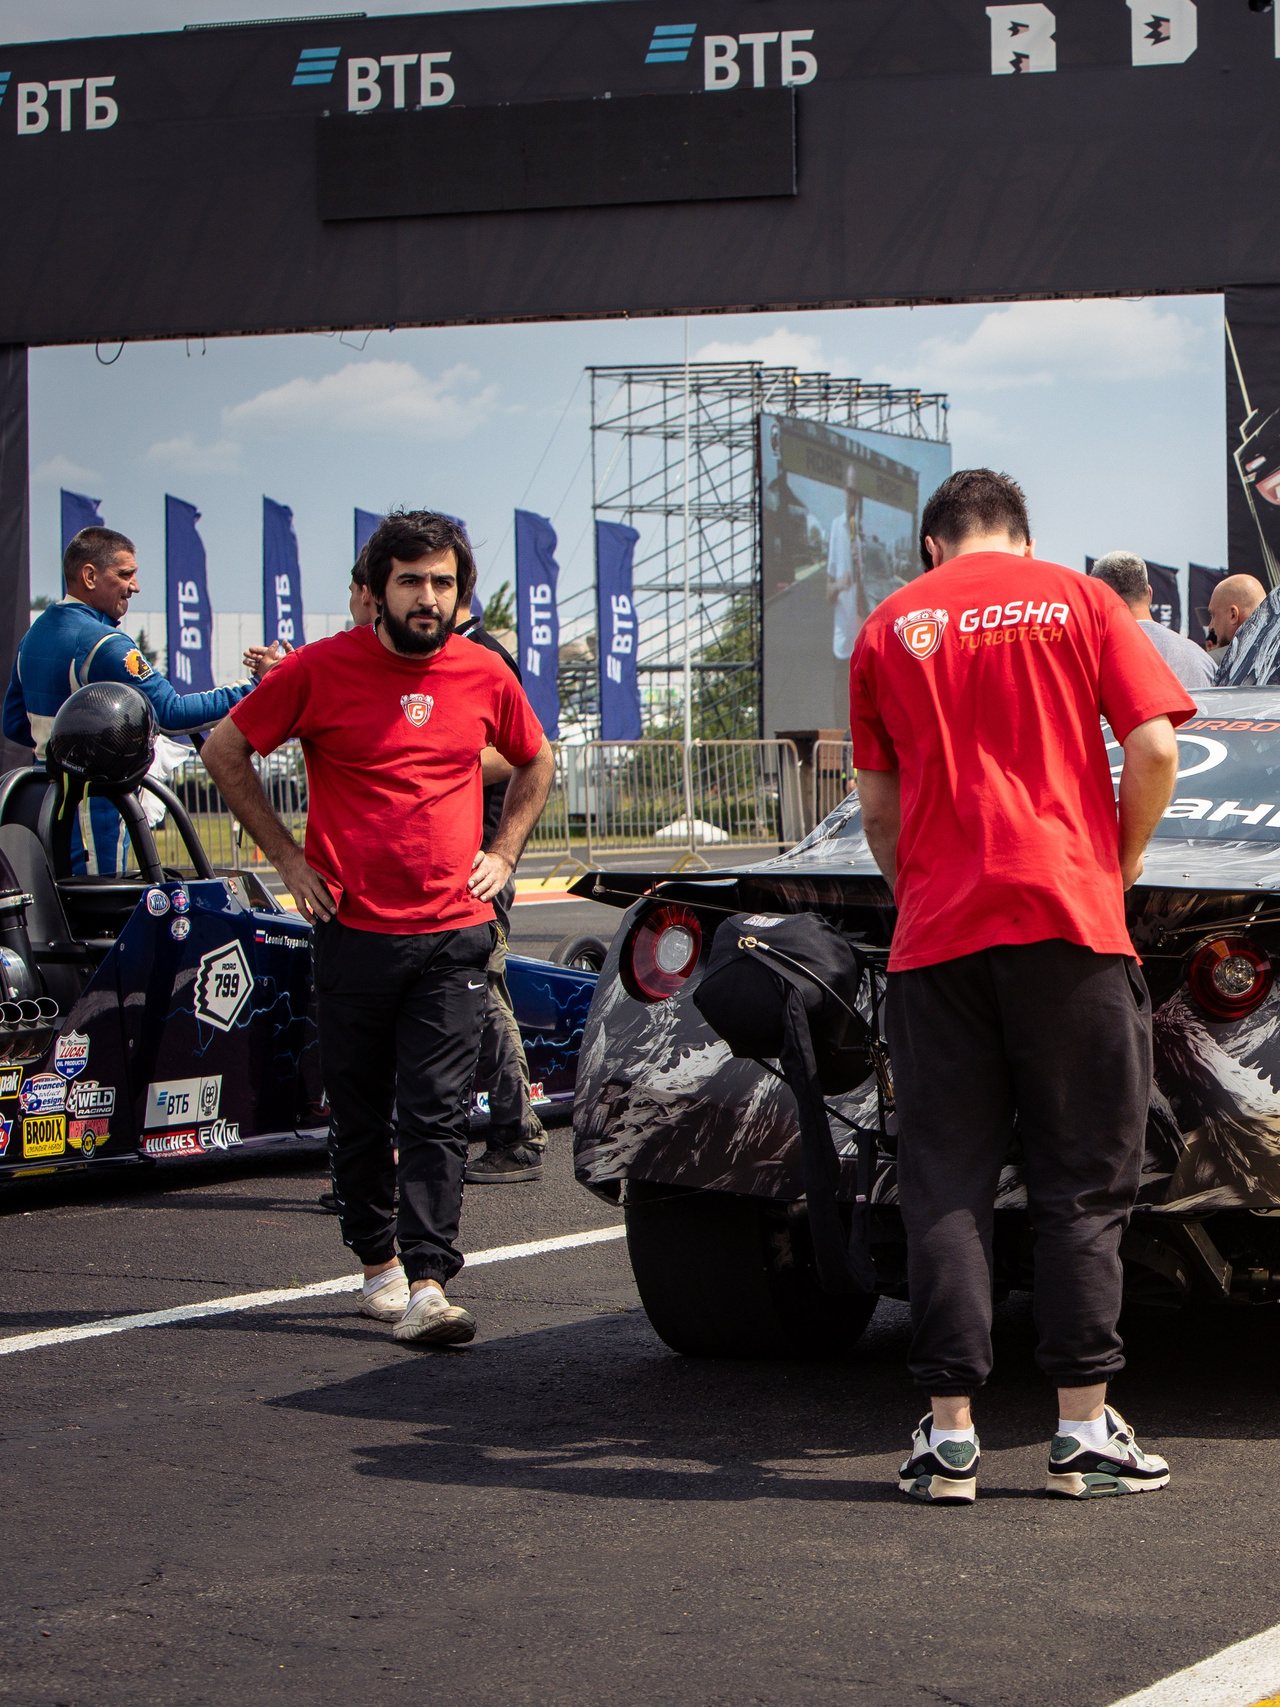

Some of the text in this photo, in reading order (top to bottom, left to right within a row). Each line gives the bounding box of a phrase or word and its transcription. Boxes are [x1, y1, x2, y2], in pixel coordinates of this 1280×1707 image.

[704, 29, 818, 91] ВТБ
[348, 52, 456, 111] ВТБ
[17, 75, 119, 135] ВТБ
[178, 581, 202, 650] ВТБ
[275, 574, 295, 641] ВТБ
[529, 584, 552, 646] ВТБ
[959, 601, 1070, 632] GOSHA
[611, 594, 634, 655] ВТБ
[958, 626, 1064, 650] TURBOTECH
[265, 933, 284, 945] Leonid
[214, 973, 240, 998] 799
[60, 1046, 87, 1058] LUCAS
[64, 1059, 86, 1067] PRODUCTS
[20, 1079, 65, 1095] Advanced
[78, 1090, 113, 1108] WELD
[27, 1097, 63, 1112] Design
[78, 1106, 112, 1115] RACING
[167, 1093, 190, 1115] ВТБ
[26, 1118, 63, 1145] BRODIX
[145, 1133, 195, 1153] HUGHES
